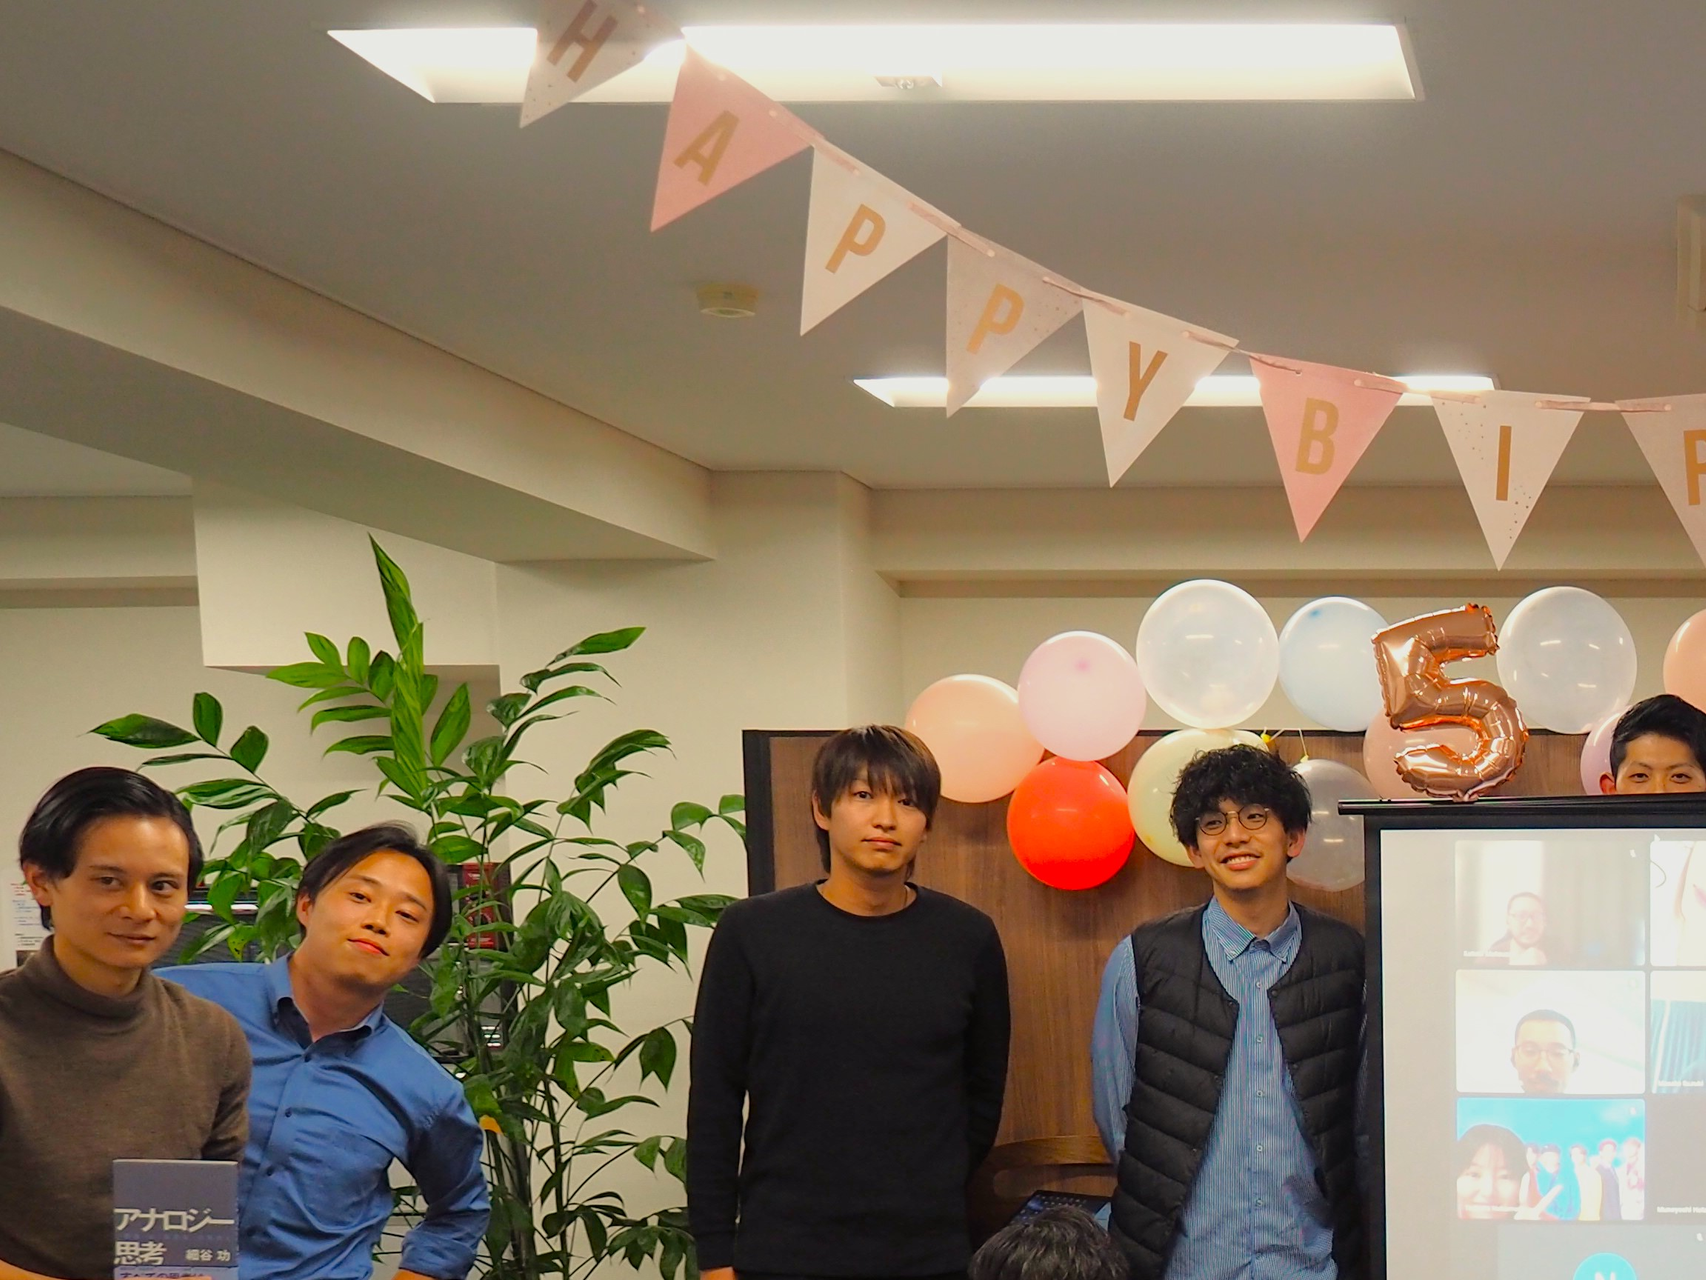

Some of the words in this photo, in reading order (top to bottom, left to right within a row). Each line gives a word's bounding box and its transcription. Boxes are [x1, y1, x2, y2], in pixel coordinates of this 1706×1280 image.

[547, 0, 1168, 421] HAPPY
[1371, 602, 1530, 801] 5
[113, 1207, 235, 1233] アナロジー
[113, 1240, 167, 1266] 思考
